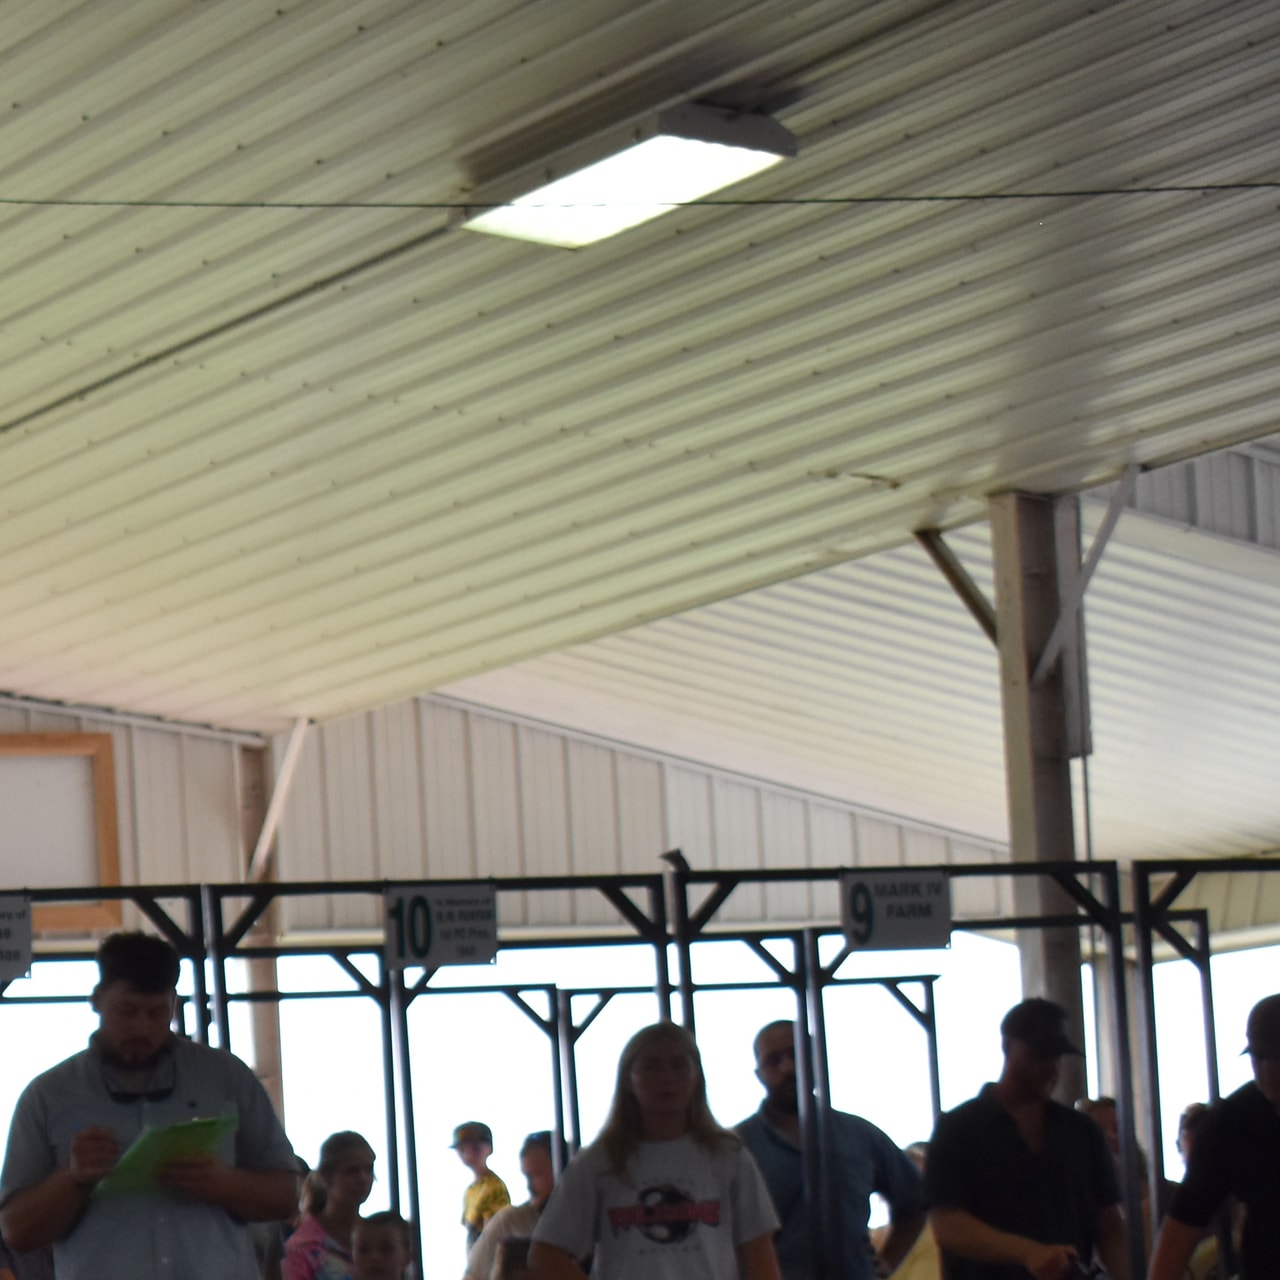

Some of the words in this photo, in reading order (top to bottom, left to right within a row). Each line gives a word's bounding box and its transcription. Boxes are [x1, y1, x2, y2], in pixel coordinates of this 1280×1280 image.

[388, 895, 432, 959] 10
[850, 881, 873, 945] 9
[885, 903, 933, 919] FARM
